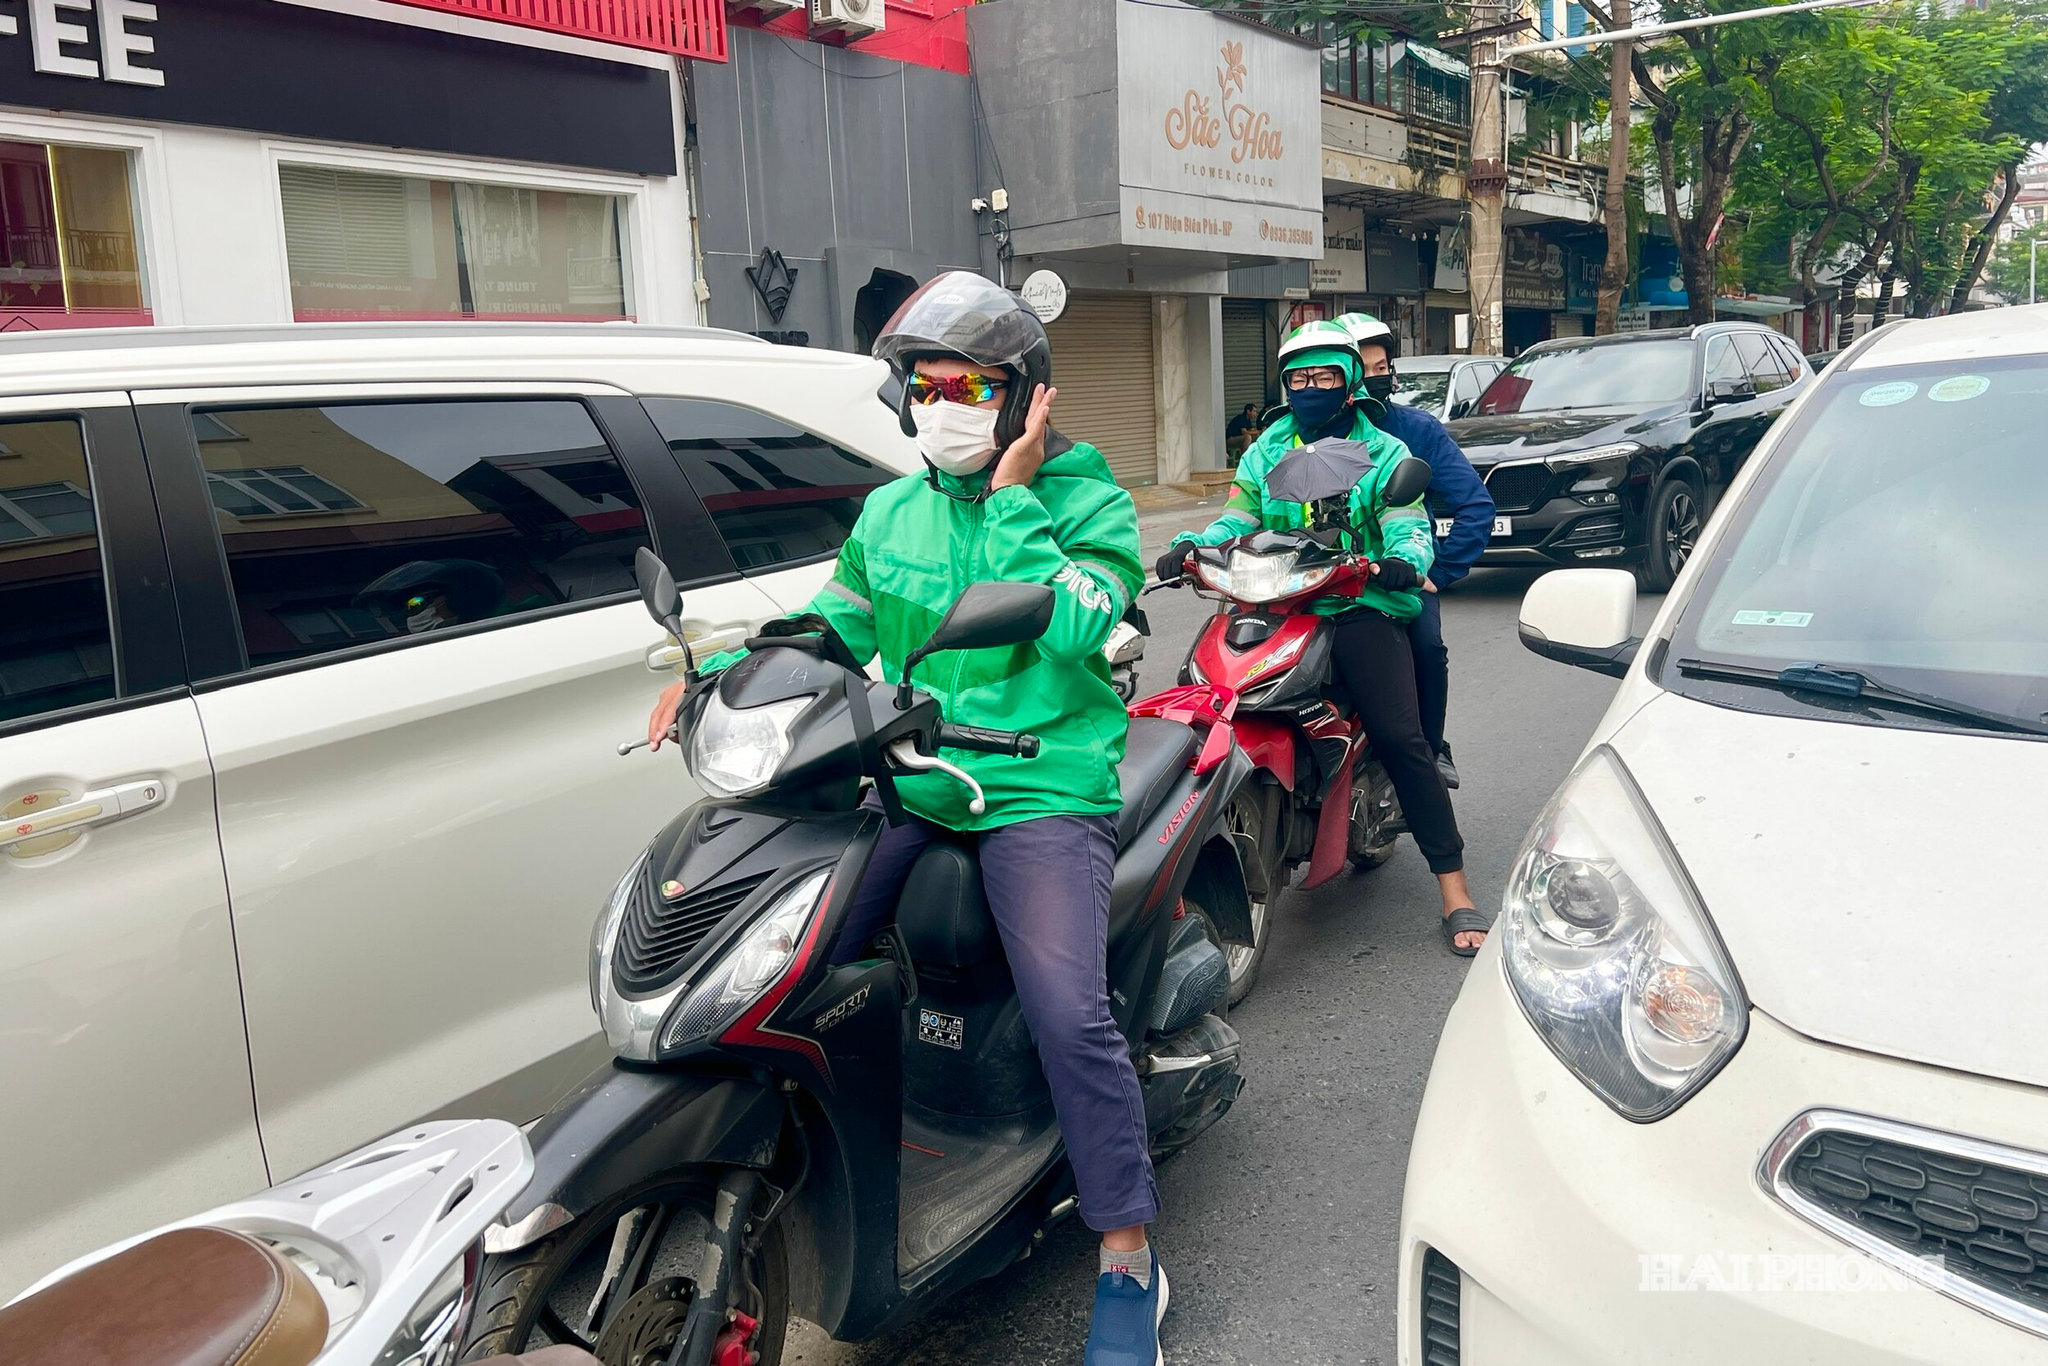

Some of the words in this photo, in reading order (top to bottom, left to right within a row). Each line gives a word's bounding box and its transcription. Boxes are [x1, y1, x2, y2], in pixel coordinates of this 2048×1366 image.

[0, 0, 165, 86] EE
[1165, 89, 1221, 150] Sắc
[1229, 103, 1283, 164] Hoa
[1184, 163, 1231, 181] FLOWER
[1236, 172, 1274, 188] COLOR
[1148, 211, 1163, 230] 107
[1235, 617, 1268, 627] HONDA
[1298, 701, 1323, 717] HONDA
[1157, 788, 1200, 845] VISION
[812, 982, 872, 1031] SPORTY
